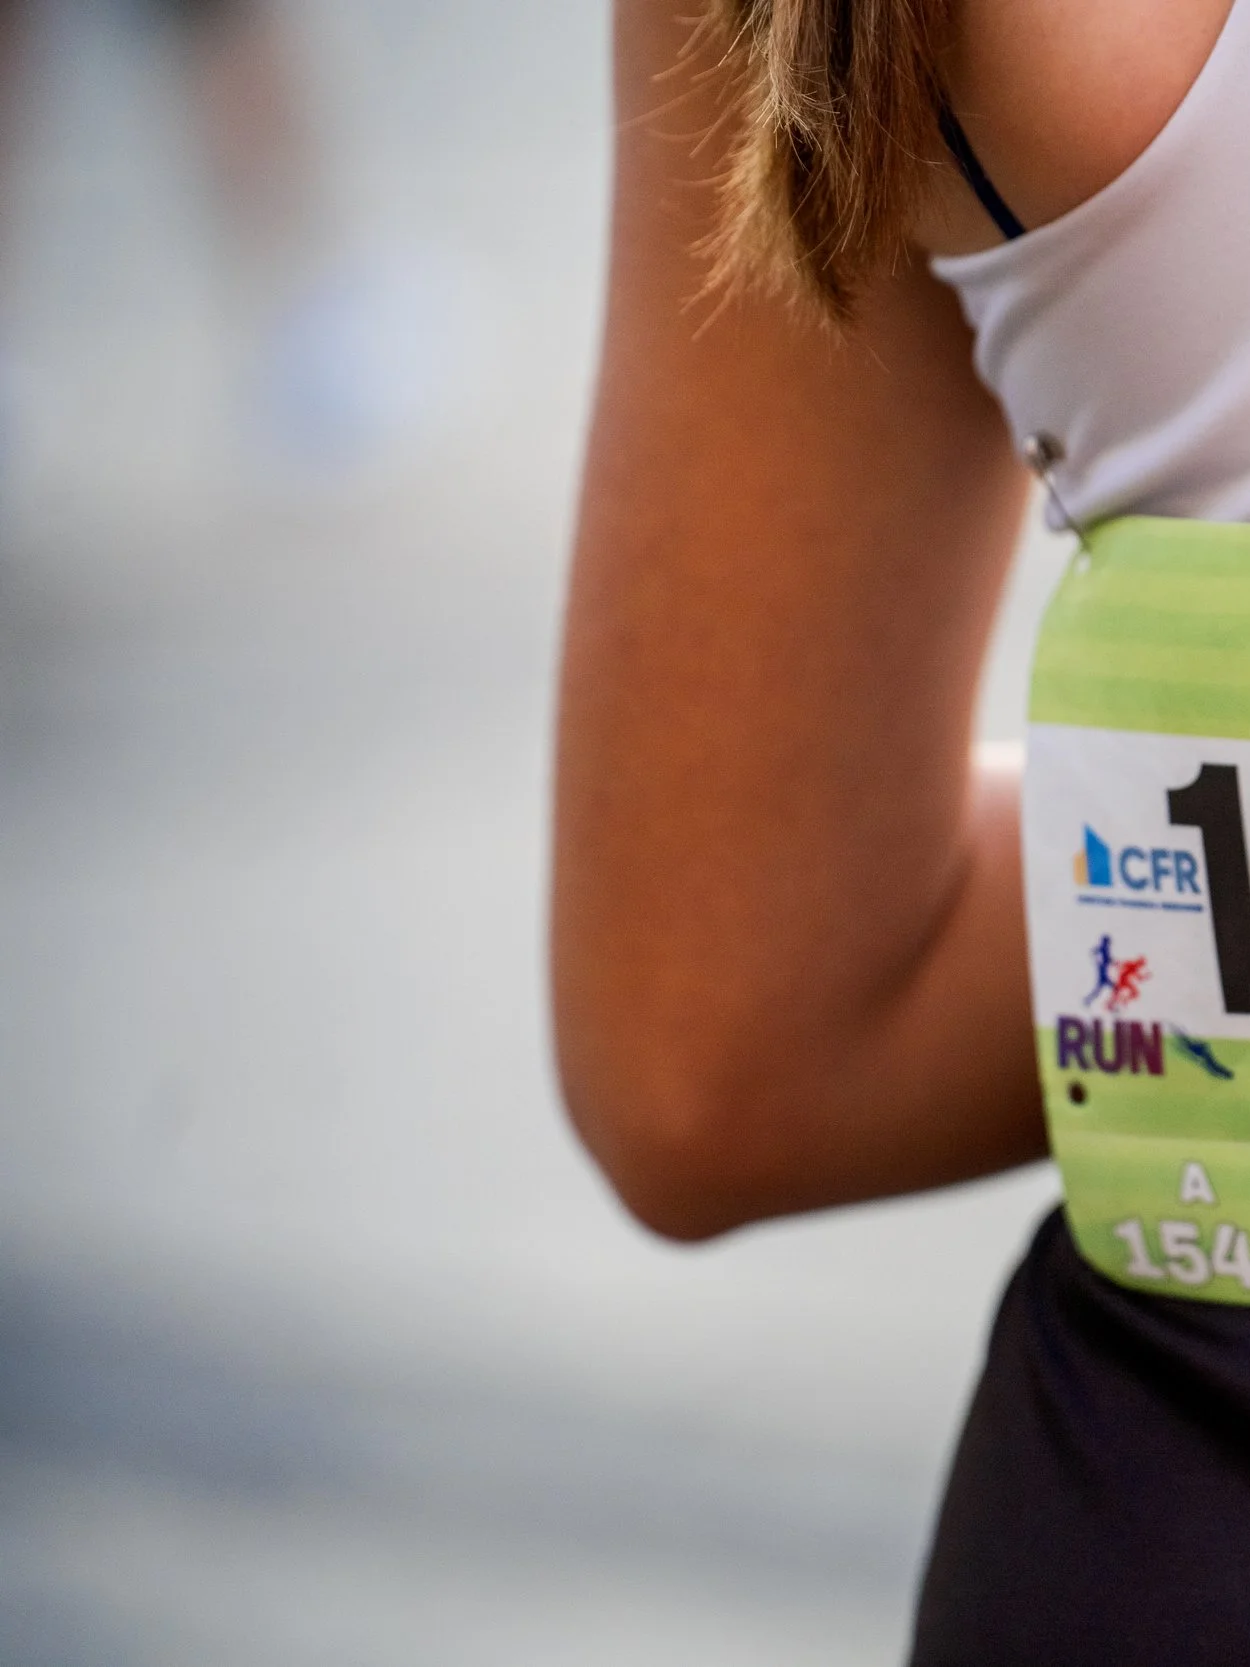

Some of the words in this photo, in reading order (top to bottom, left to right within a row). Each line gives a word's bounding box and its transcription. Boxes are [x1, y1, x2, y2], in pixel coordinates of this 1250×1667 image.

[1117, 847, 1201, 895] CFR
[1057, 1017, 1164, 1074] RUN
[1179, 1162, 1215, 1204] A
